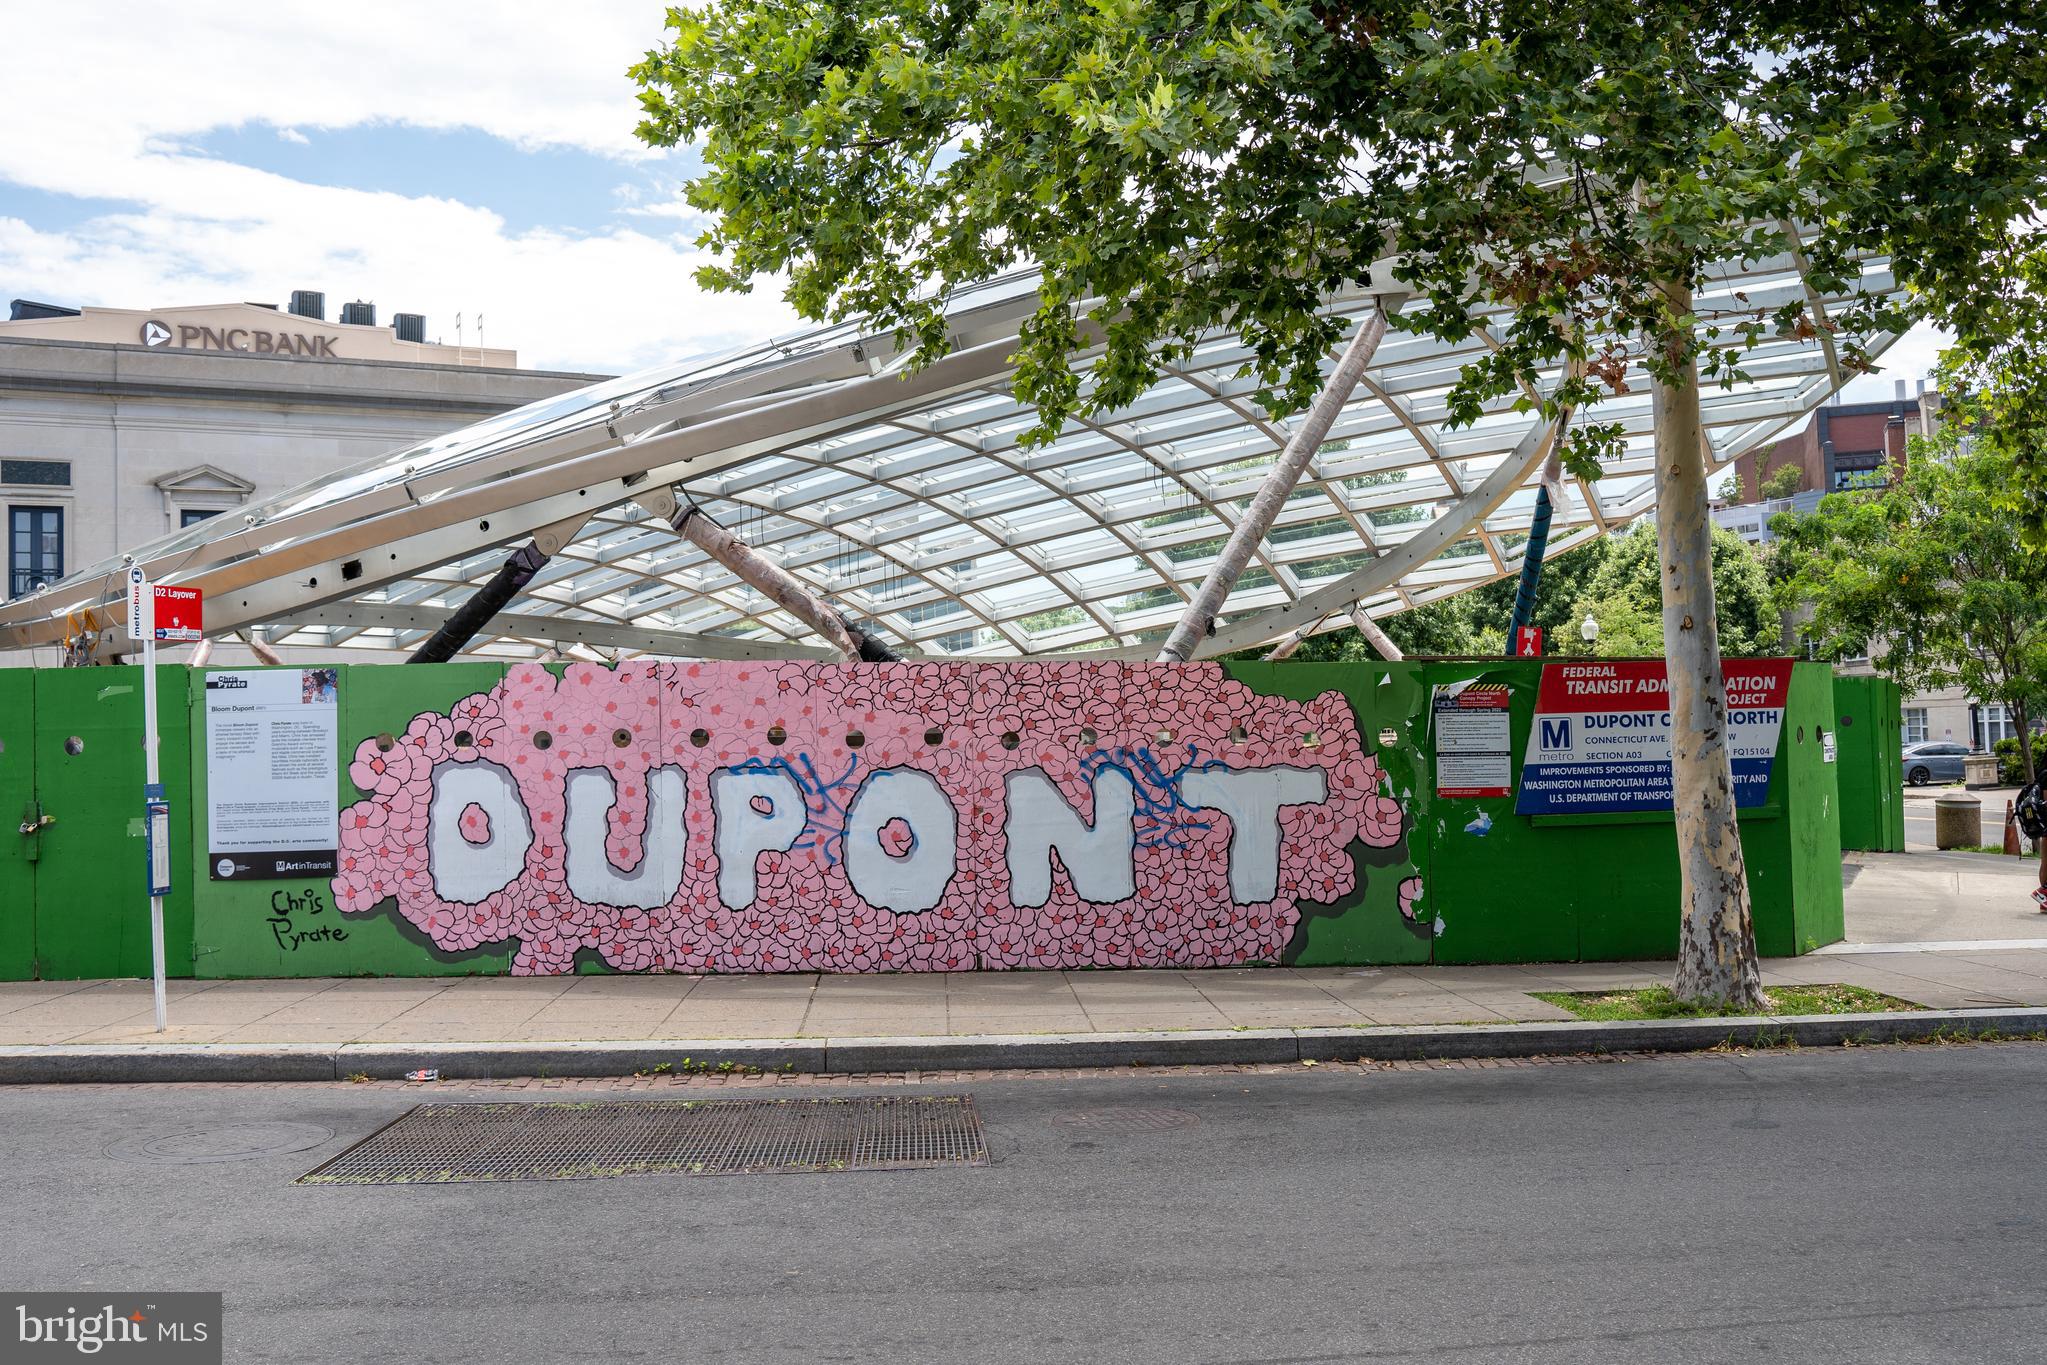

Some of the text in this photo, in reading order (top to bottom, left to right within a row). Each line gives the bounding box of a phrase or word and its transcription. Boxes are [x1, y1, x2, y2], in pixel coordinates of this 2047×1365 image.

[177, 324, 339, 358] PNC BANK
[155, 587, 197, 600] D2 Layover
[1562, 666, 1617, 678] FEDERAL
[217, 675, 239, 683] Chris
[217, 681, 246, 689] Pyrate
[1566, 679, 1634, 695] TRANSIT
[1728, 693, 1768, 705] OJECT
[211, 705, 231, 713] Bloom
[232, 705, 255, 713] Dupont
[1584, 713, 1656, 729] DUPONT
[1584, 735, 1648, 745] CONNECTICUT
[1649, 735, 1669, 743] AVE.
[1539, 751, 1575, 761] metro
[1586, 751, 1642, 760] SECTION A03
[1733, 747, 1770, 756] FQ15104
[1539, 764, 1670, 776] IMPROVEMENTS SPONSORED BY:
[1524, 779, 1582, 790] WASHINGTON
[1583, 778, 1646, 789] METROPOLITAN
[1647, 777, 1669, 786] AREA
[1749, 774, 1768, 783] AND
[1549, 794, 1565, 803] U.S.
[1566, 792, 1619, 802] DEPARTMENT
[1620, 792, 1632, 801] OF
[427, 757, 1331, 915] DUPONT
[271, 888, 324, 915] Chris
[265, 917, 349, 952] Pyrate
